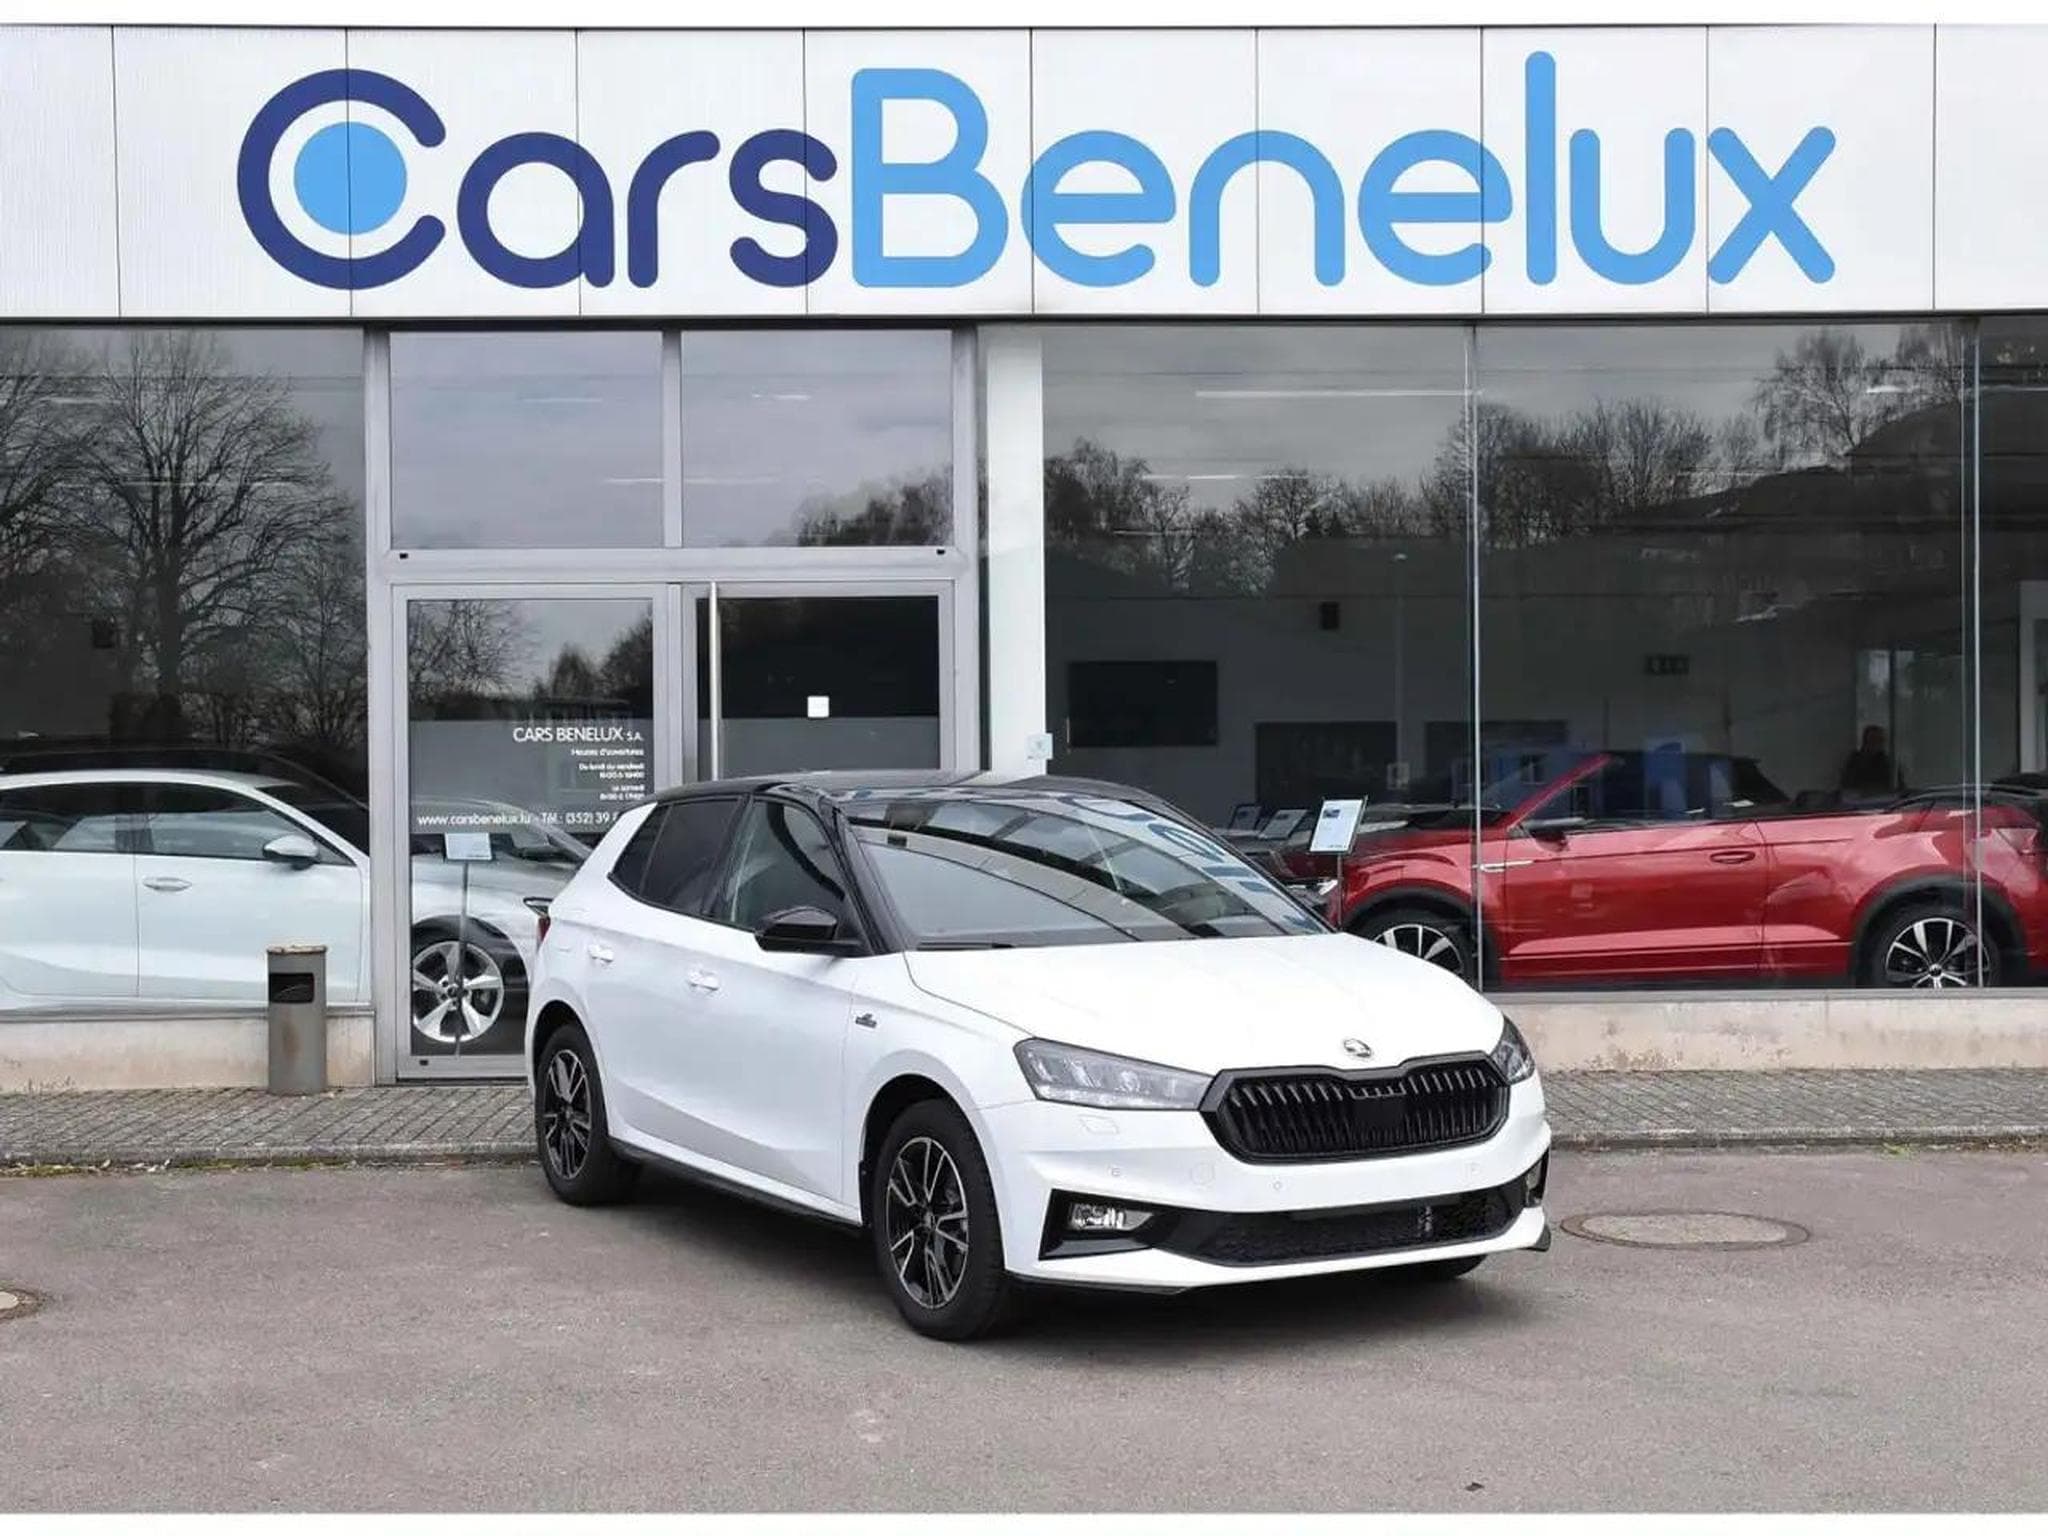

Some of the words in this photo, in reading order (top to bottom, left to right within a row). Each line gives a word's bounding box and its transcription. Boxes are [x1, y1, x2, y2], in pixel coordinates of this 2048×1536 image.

[513, 727, 553, 742] CARS
[556, 727, 623, 741] BENELUX
[417, 812, 531, 826] www.carsbenelux.lu
[595, 811, 610, 823] 39
